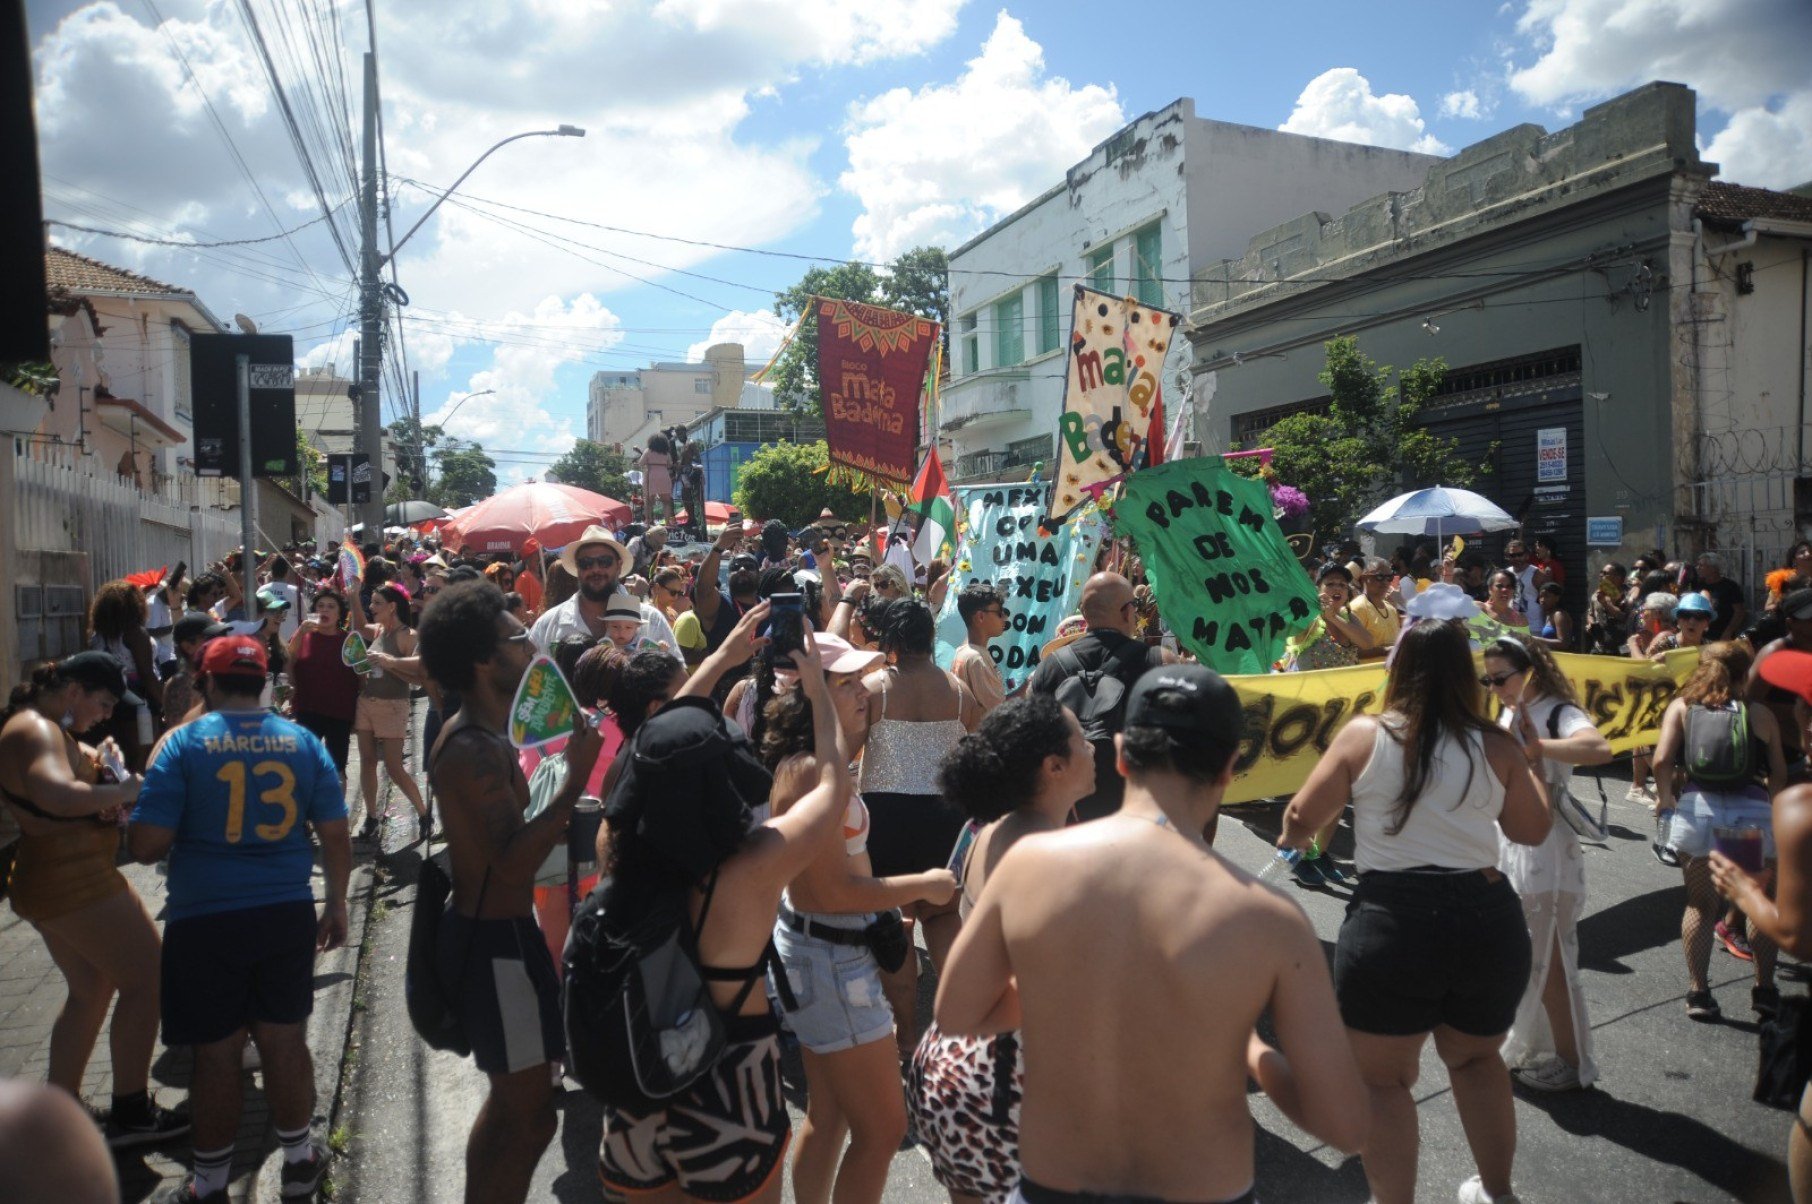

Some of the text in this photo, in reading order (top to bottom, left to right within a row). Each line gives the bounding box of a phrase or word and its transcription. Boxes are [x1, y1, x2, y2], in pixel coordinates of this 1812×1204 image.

[1145, 481, 1265, 533] PAREM
[996, 515, 1061, 537] CO
[992, 541, 1060, 567] UMA
[1193, 531, 1236, 561] DE
[969, 573, 1067, 603] EXEU
[1205, 567, 1271, 604] NOS
[1192, 596, 1310, 653] MATAR
[216, 760, 298, 844] 13
